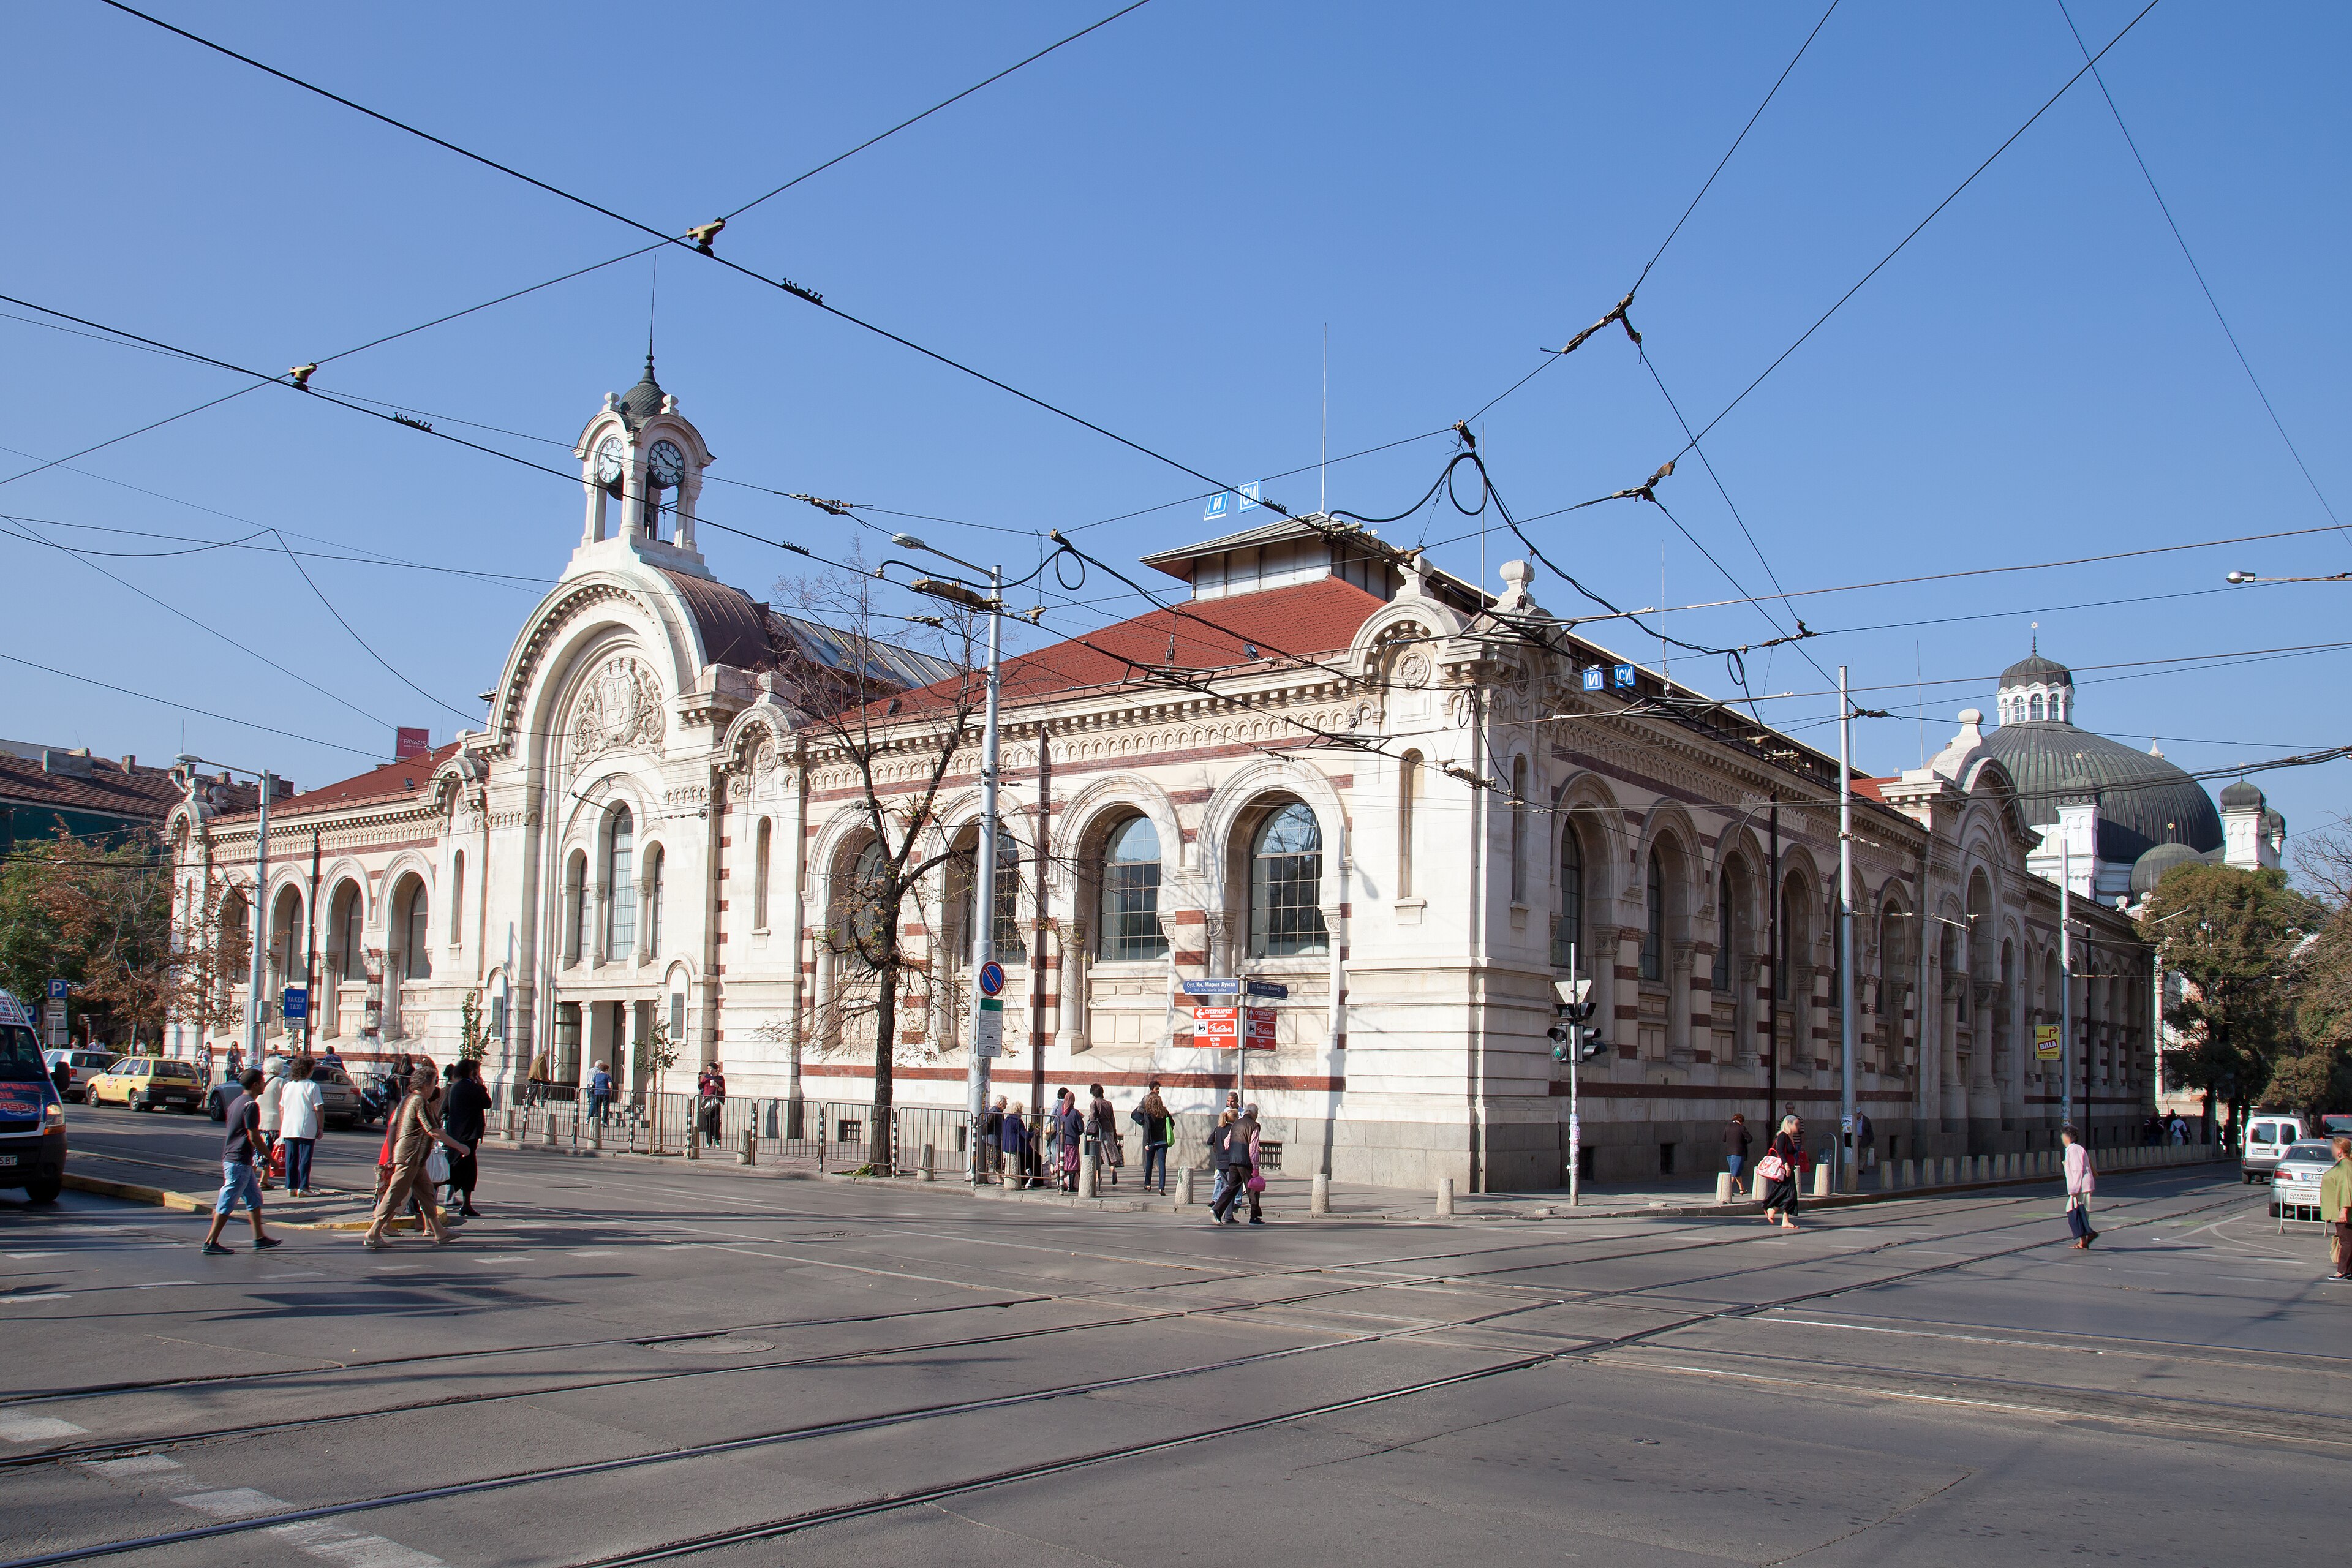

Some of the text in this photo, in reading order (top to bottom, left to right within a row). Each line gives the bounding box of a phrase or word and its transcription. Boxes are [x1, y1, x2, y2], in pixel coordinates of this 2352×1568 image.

[1213, 496, 1223, 511] И
[1588, 673, 1598, 686] И
[51, 981, 63, 996] P
[2039, 1041, 2057, 1050] BILLA
